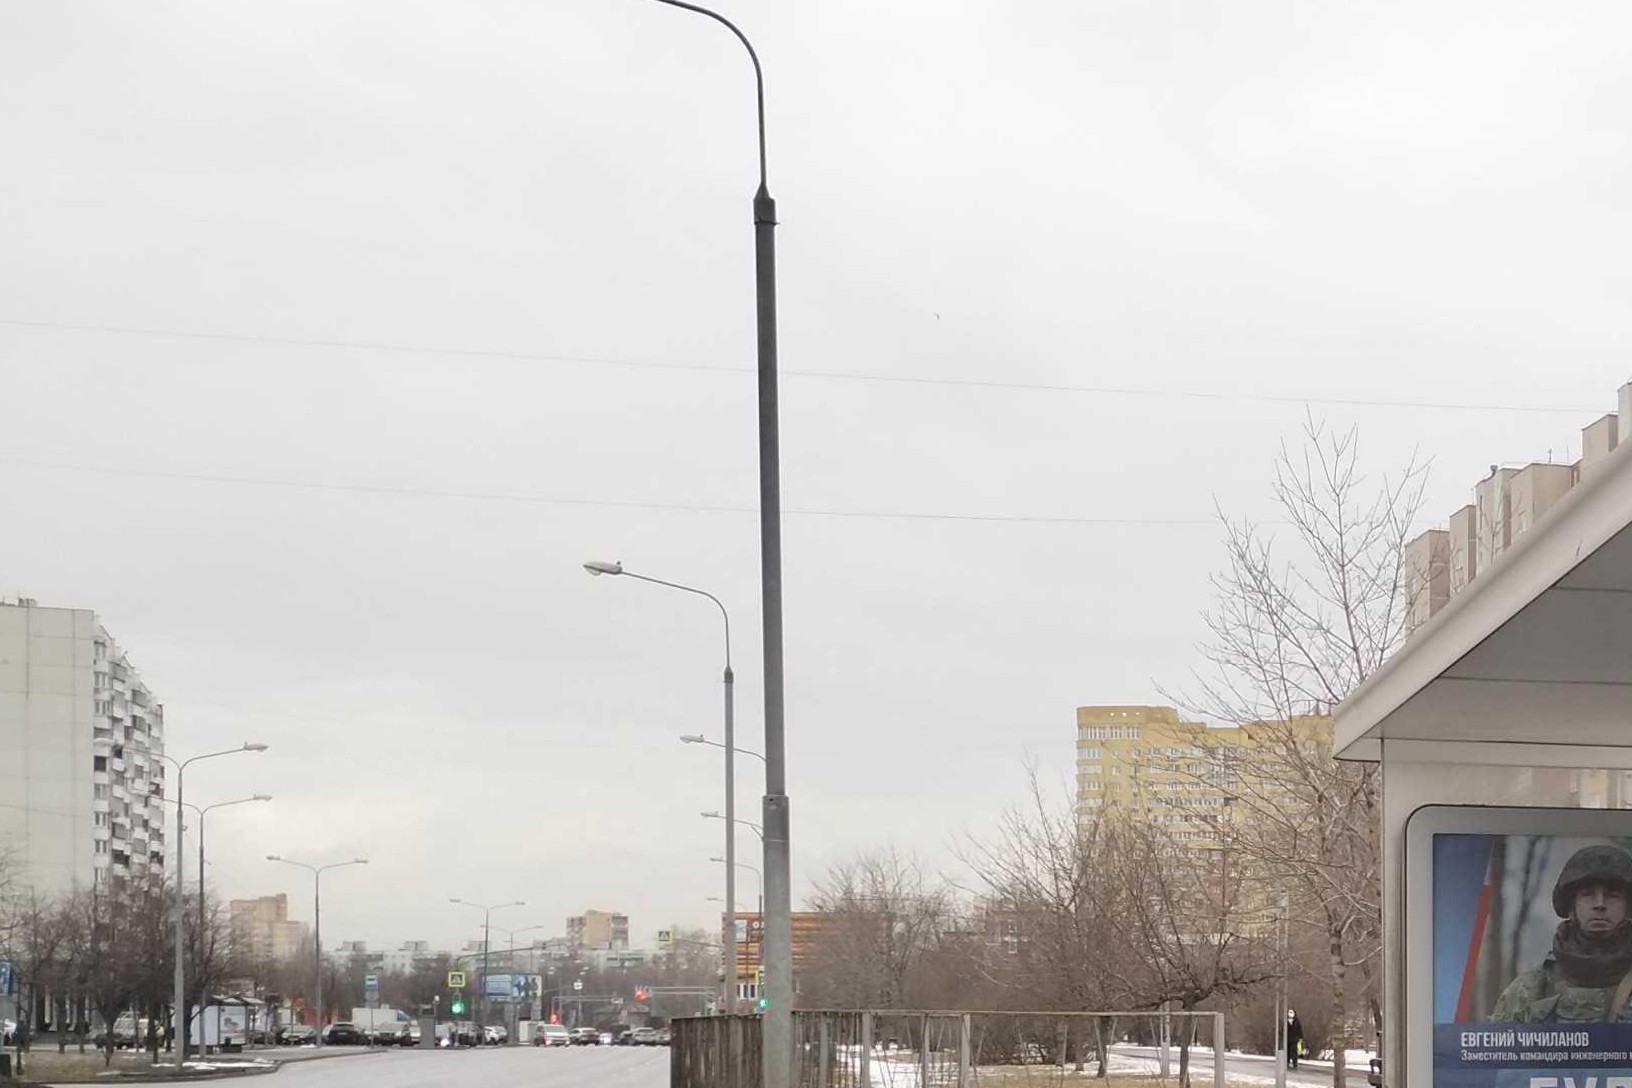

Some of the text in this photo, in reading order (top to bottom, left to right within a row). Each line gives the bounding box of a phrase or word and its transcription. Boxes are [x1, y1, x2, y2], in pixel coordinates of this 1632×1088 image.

[1461, 1029, 1589, 1048] ЕВГЕНИЙ ЧИЧИЛАНОВ
[1461, 1050, 1518, 1061] Заместитель
[1520, 1051, 1568, 1063] командира
[1571, 1051, 1627, 1063] инженерного
